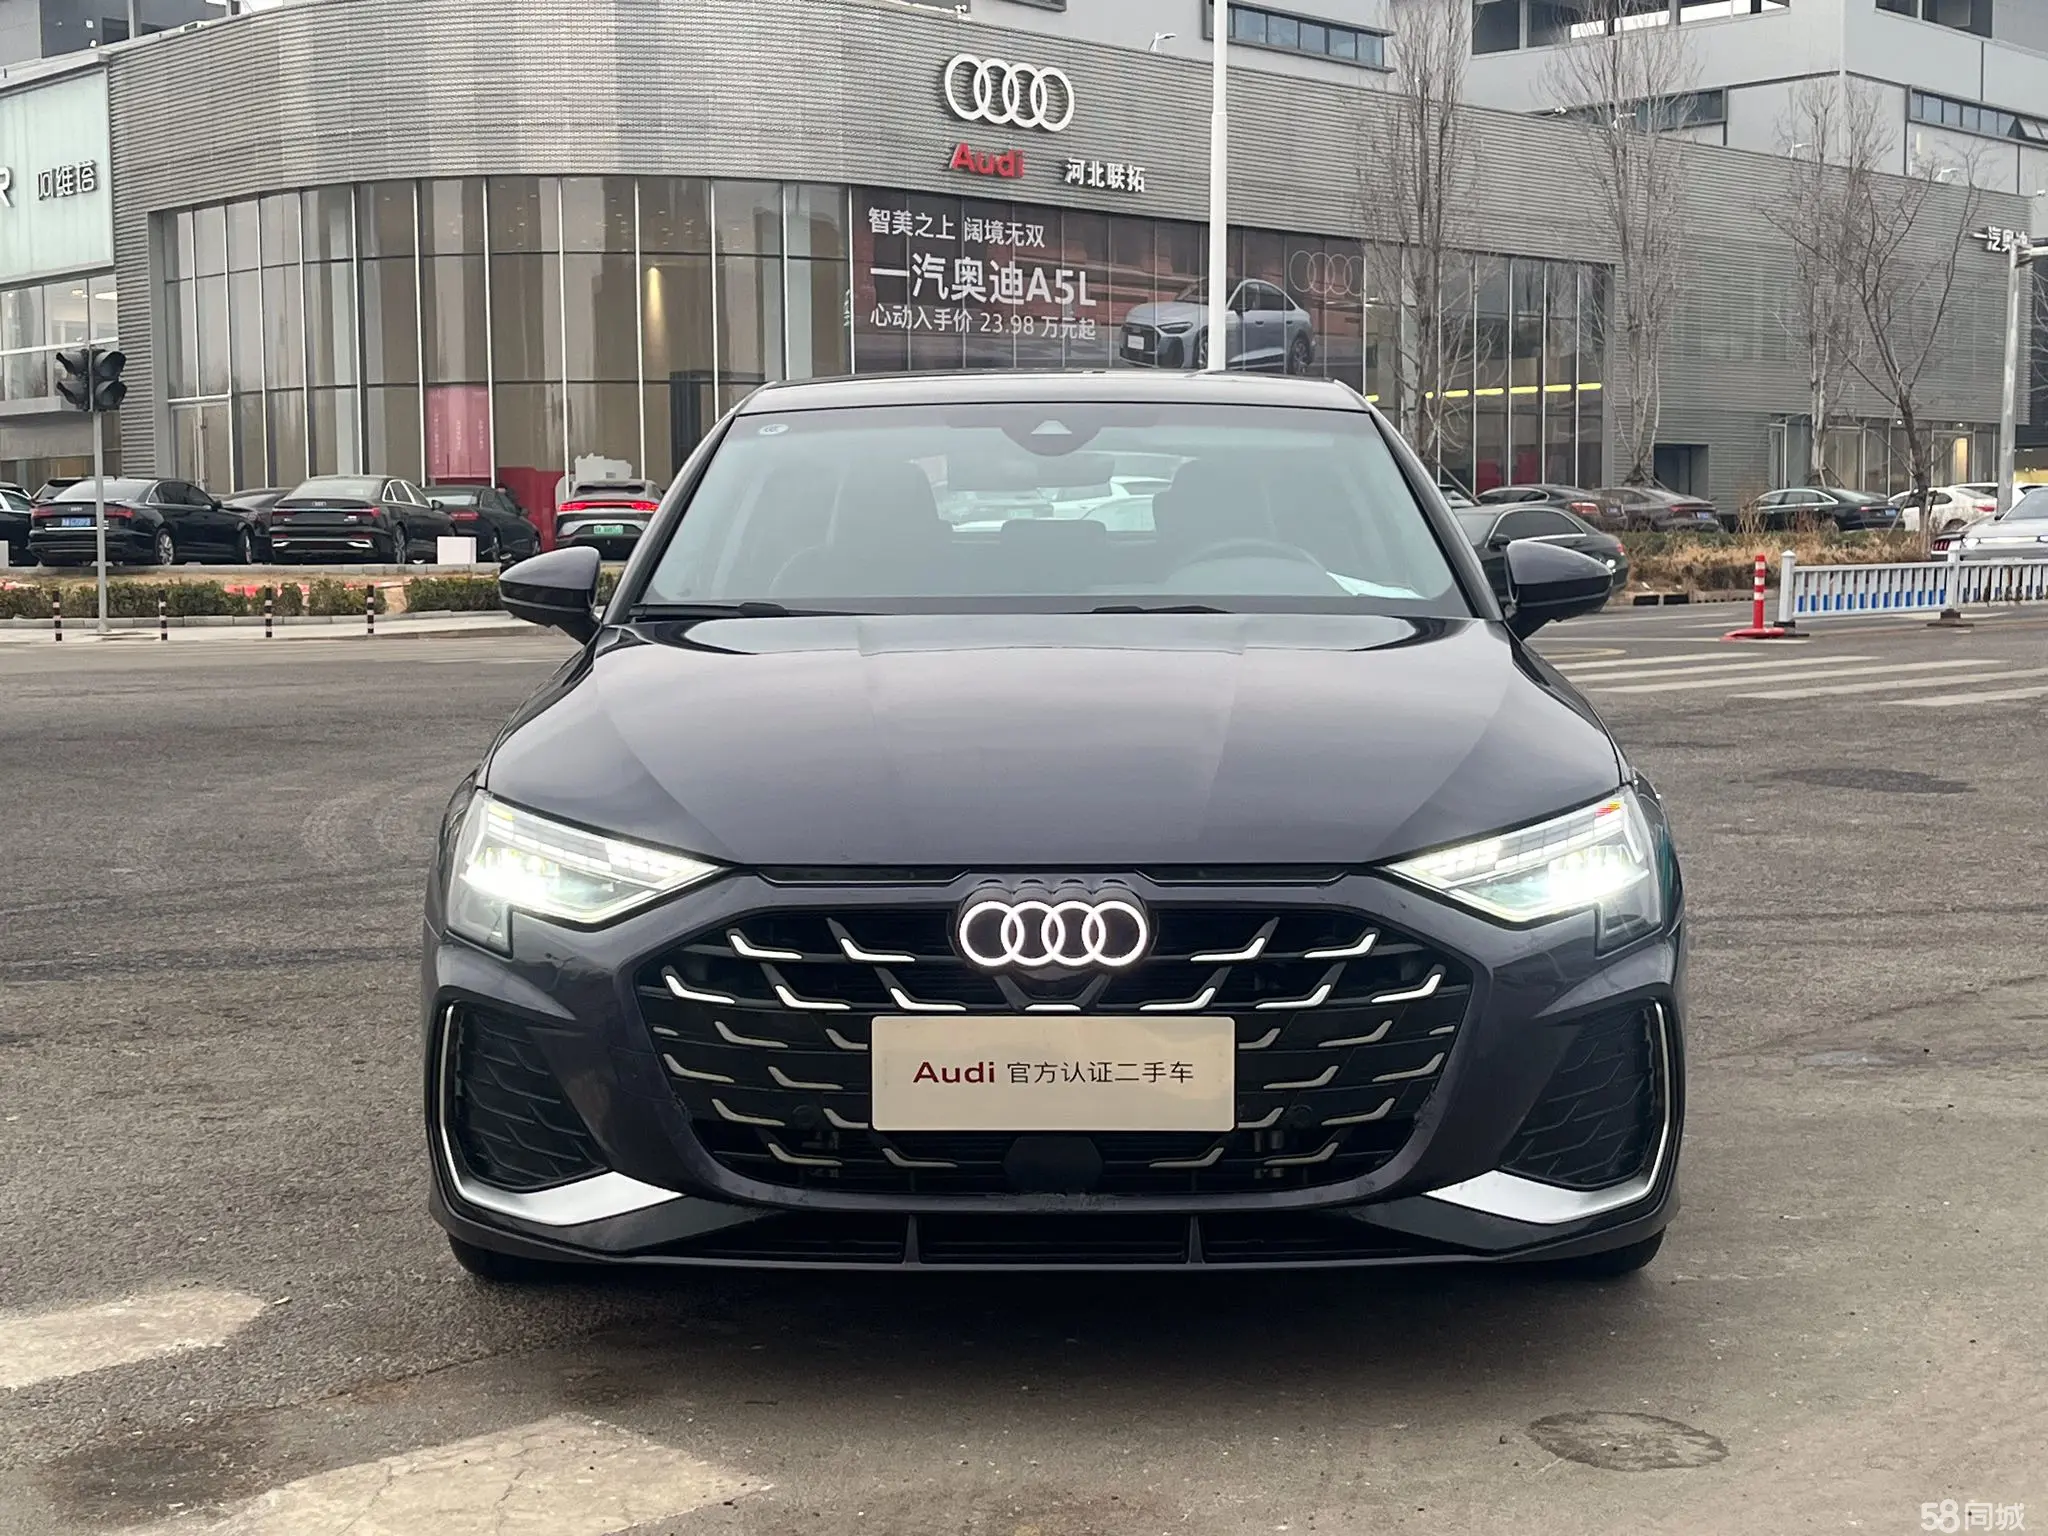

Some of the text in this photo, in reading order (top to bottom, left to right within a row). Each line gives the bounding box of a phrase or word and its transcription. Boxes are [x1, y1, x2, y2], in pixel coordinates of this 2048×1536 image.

[949, 141, 1025, 179] Audi
[1064, 157, 1146, 192] 河北联拓
[868, 206, 1046, 249] 智美之上 阔境无双
[869, 252, 1097, 307] 一汽奥迪A5L
[869, 302, 974, 334] 心动入手价
[980, 311, 1035, 336] 23.98
[1041, 315, 1097, 341] 万元起
[912, 1061, 1195, 1084] Audi 官方认证二手车
